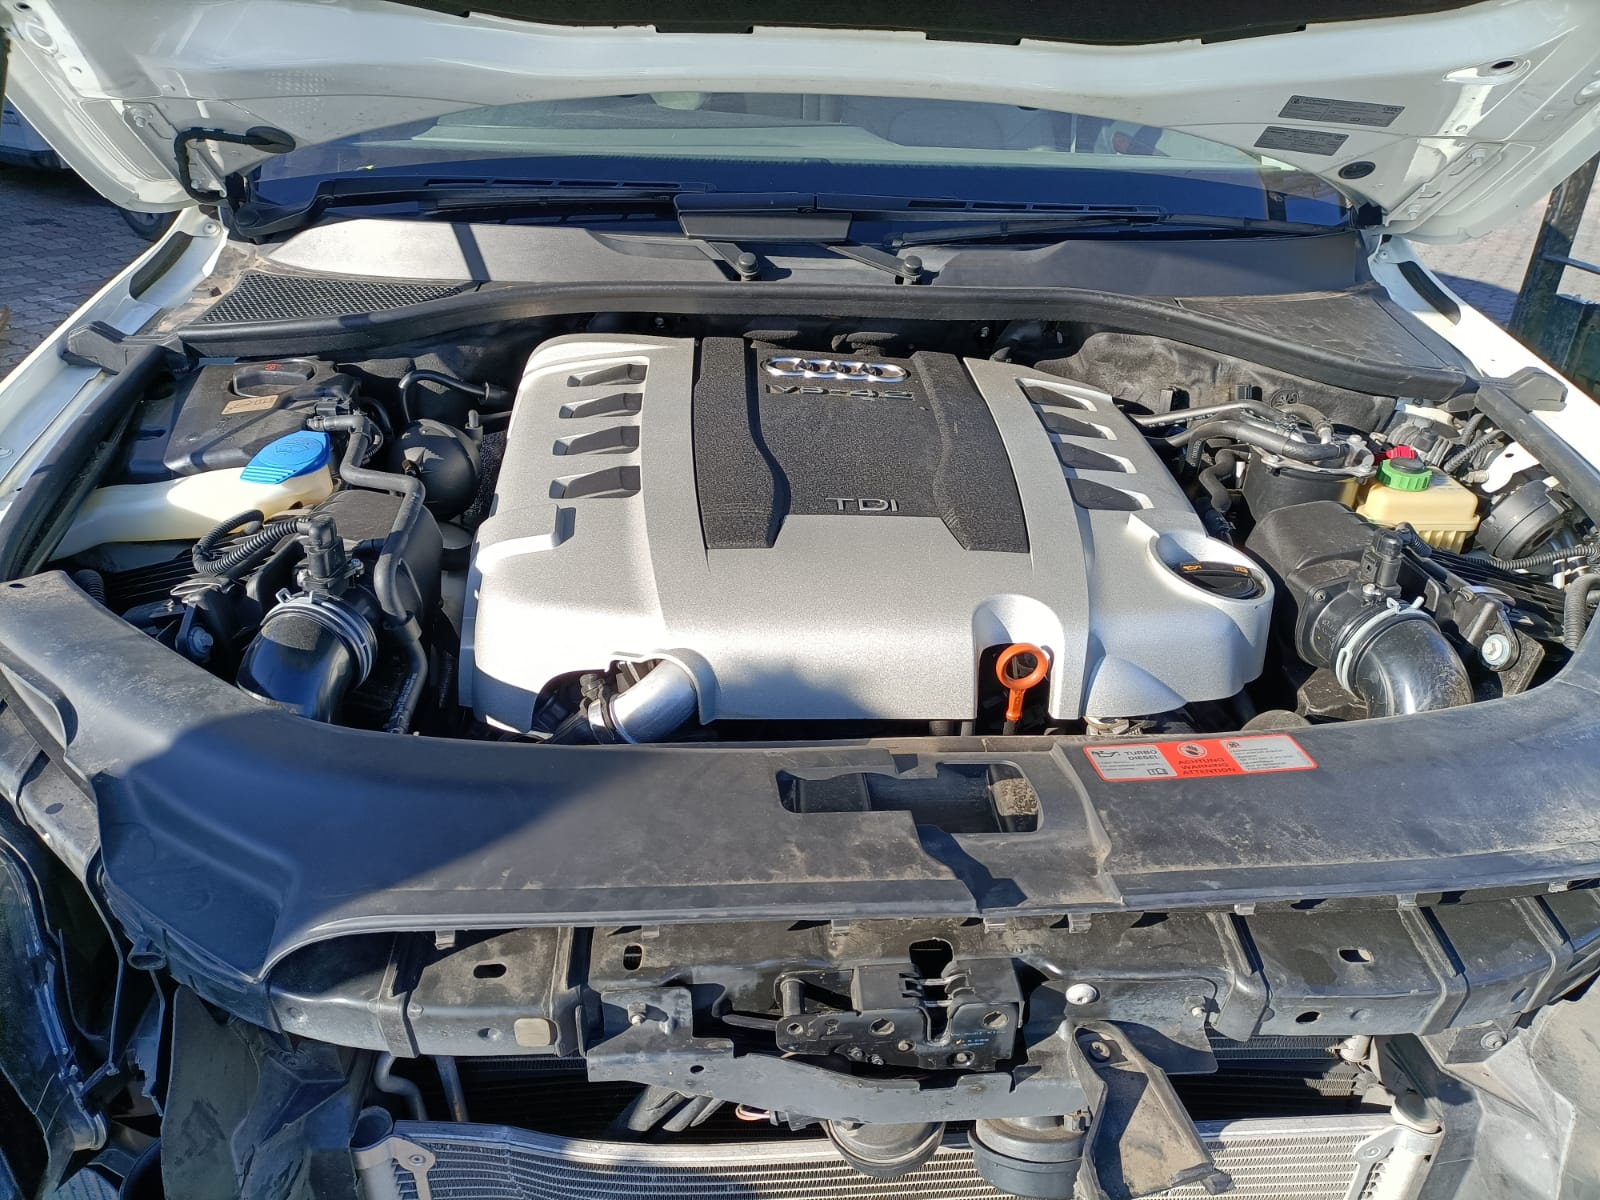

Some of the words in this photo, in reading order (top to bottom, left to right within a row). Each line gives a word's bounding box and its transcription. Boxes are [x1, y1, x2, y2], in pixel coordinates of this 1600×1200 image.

[824, 498, 900, 512] TDI
[1178, 757, 1225, 765] ACHTUNG
[1182, 767, 1236, 775] ATTENTION
